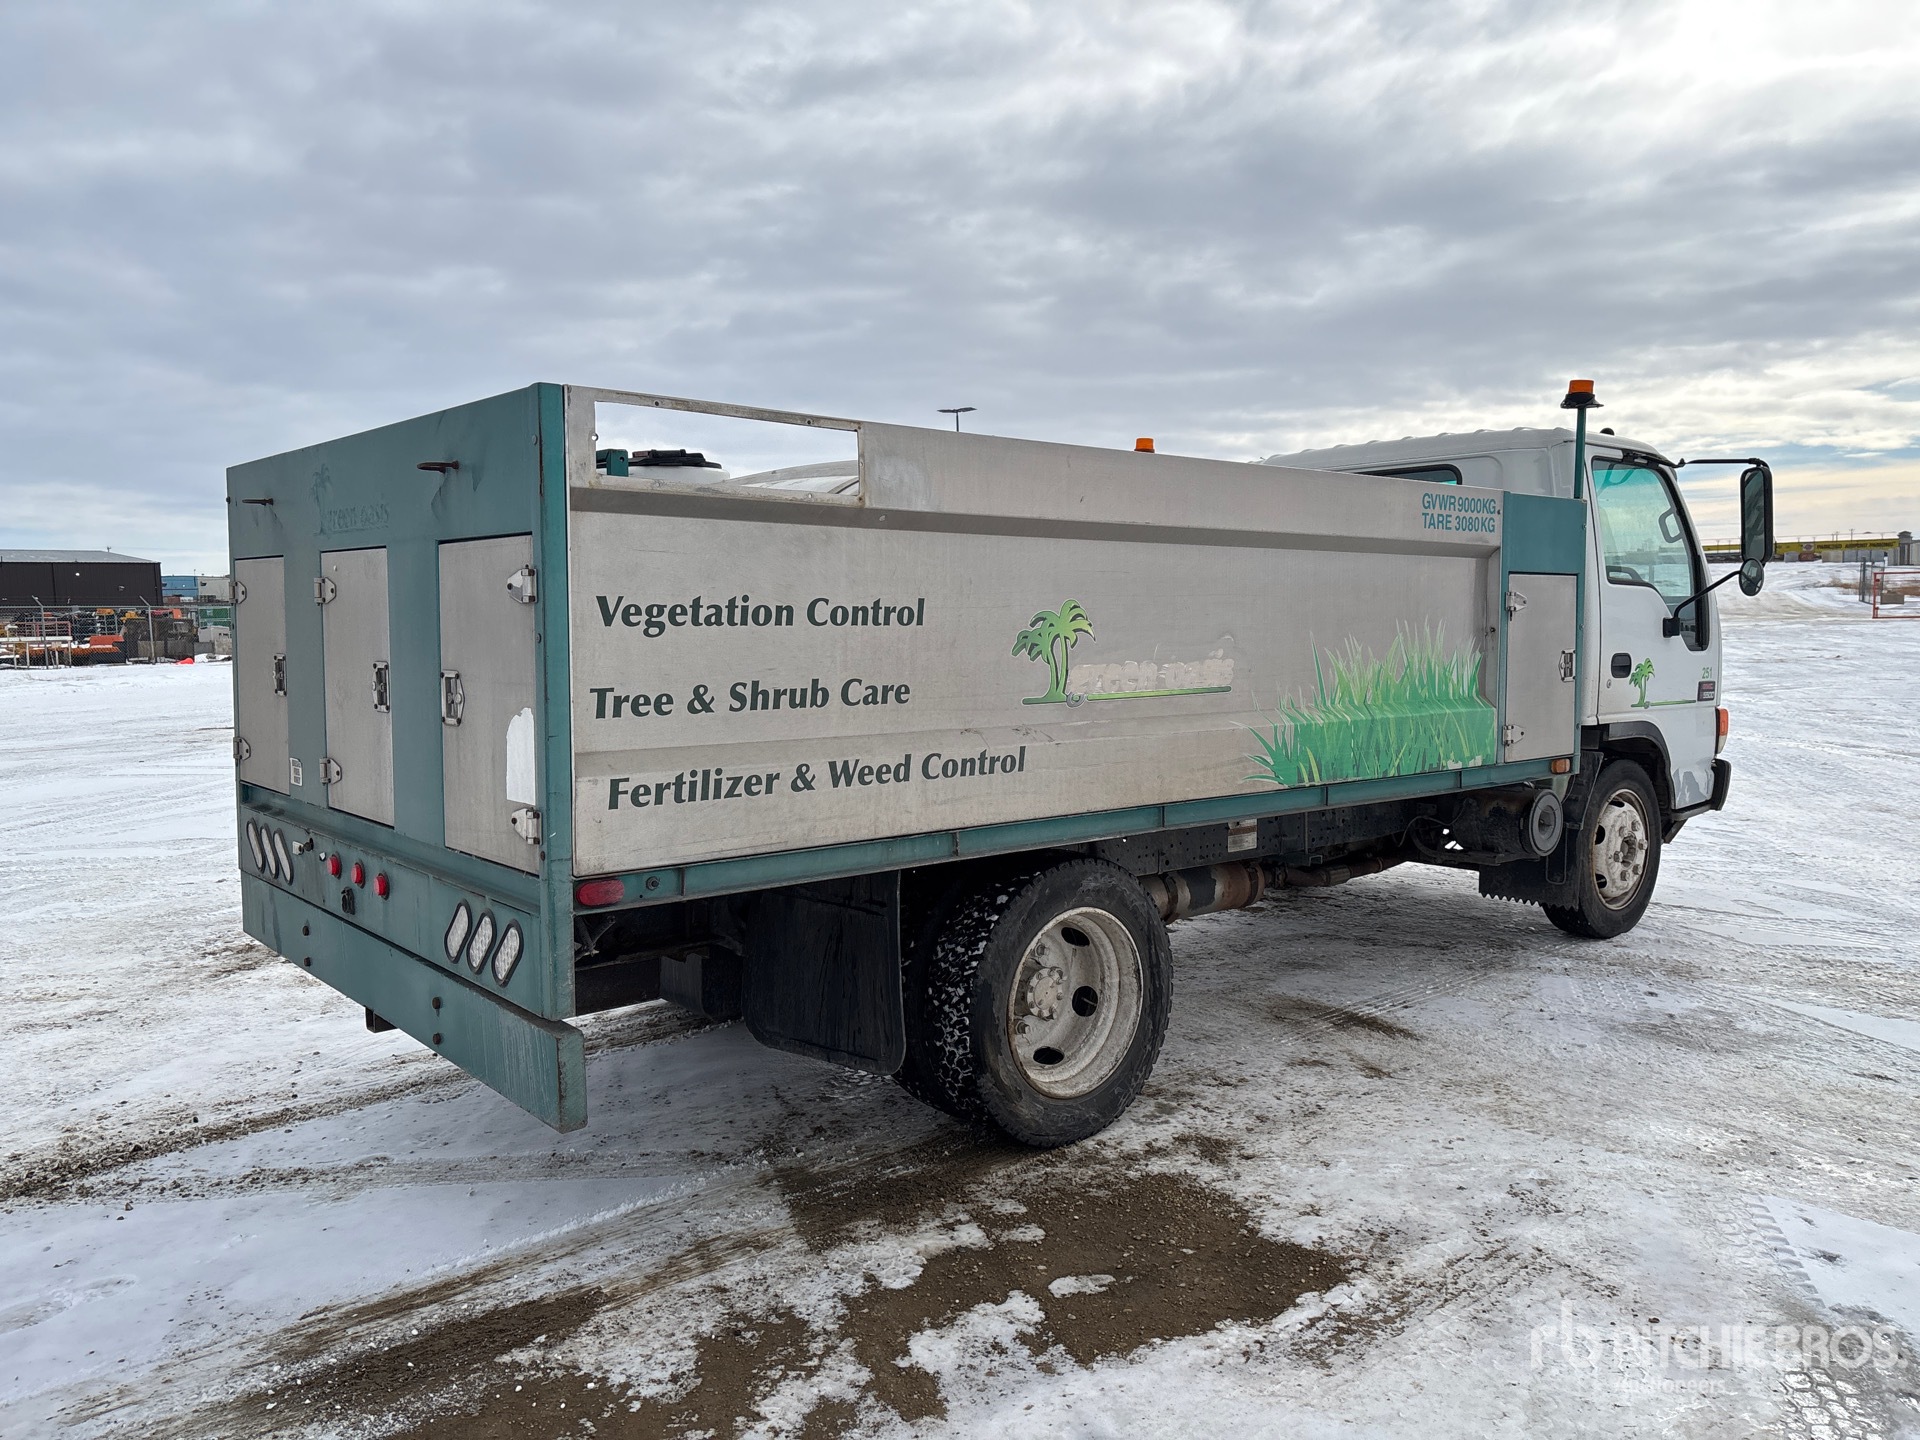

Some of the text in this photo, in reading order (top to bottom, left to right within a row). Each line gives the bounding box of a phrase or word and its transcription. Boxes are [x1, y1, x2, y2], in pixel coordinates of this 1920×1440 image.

[1422, 493, 1496, 514] GVWR 9000KG
[1422, 513, 1495, 533] TARE 3080KG
[596, 595, 925, 638] Vegetation Control
[590, 678, 911, 719] Tree & Shrub Care
[607, 746, 1027, 810] Fertilizer & Weed Control
